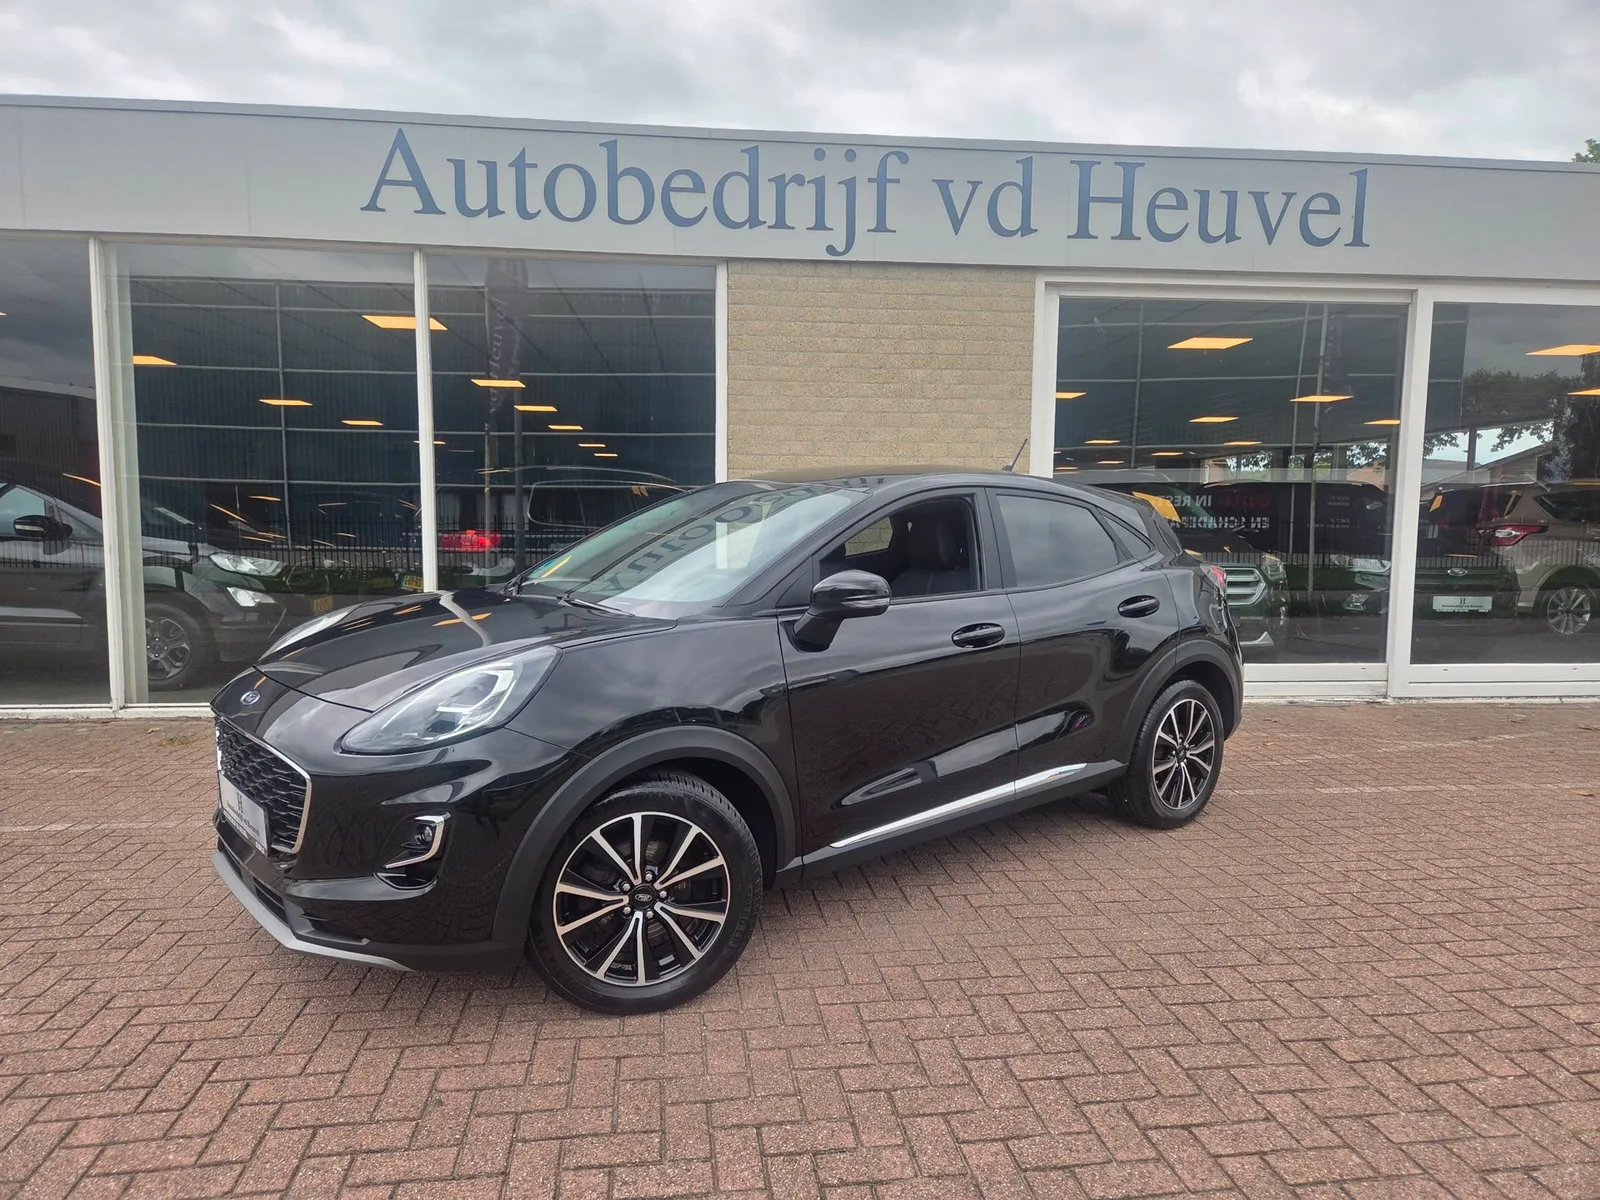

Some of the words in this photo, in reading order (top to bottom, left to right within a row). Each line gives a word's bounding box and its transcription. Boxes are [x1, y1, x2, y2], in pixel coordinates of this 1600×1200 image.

[360, 127, 909, 256] Autobedrijf
[931, 156, 1038, 238] vd
[1067, 159, 1370, 248] Heuvel
